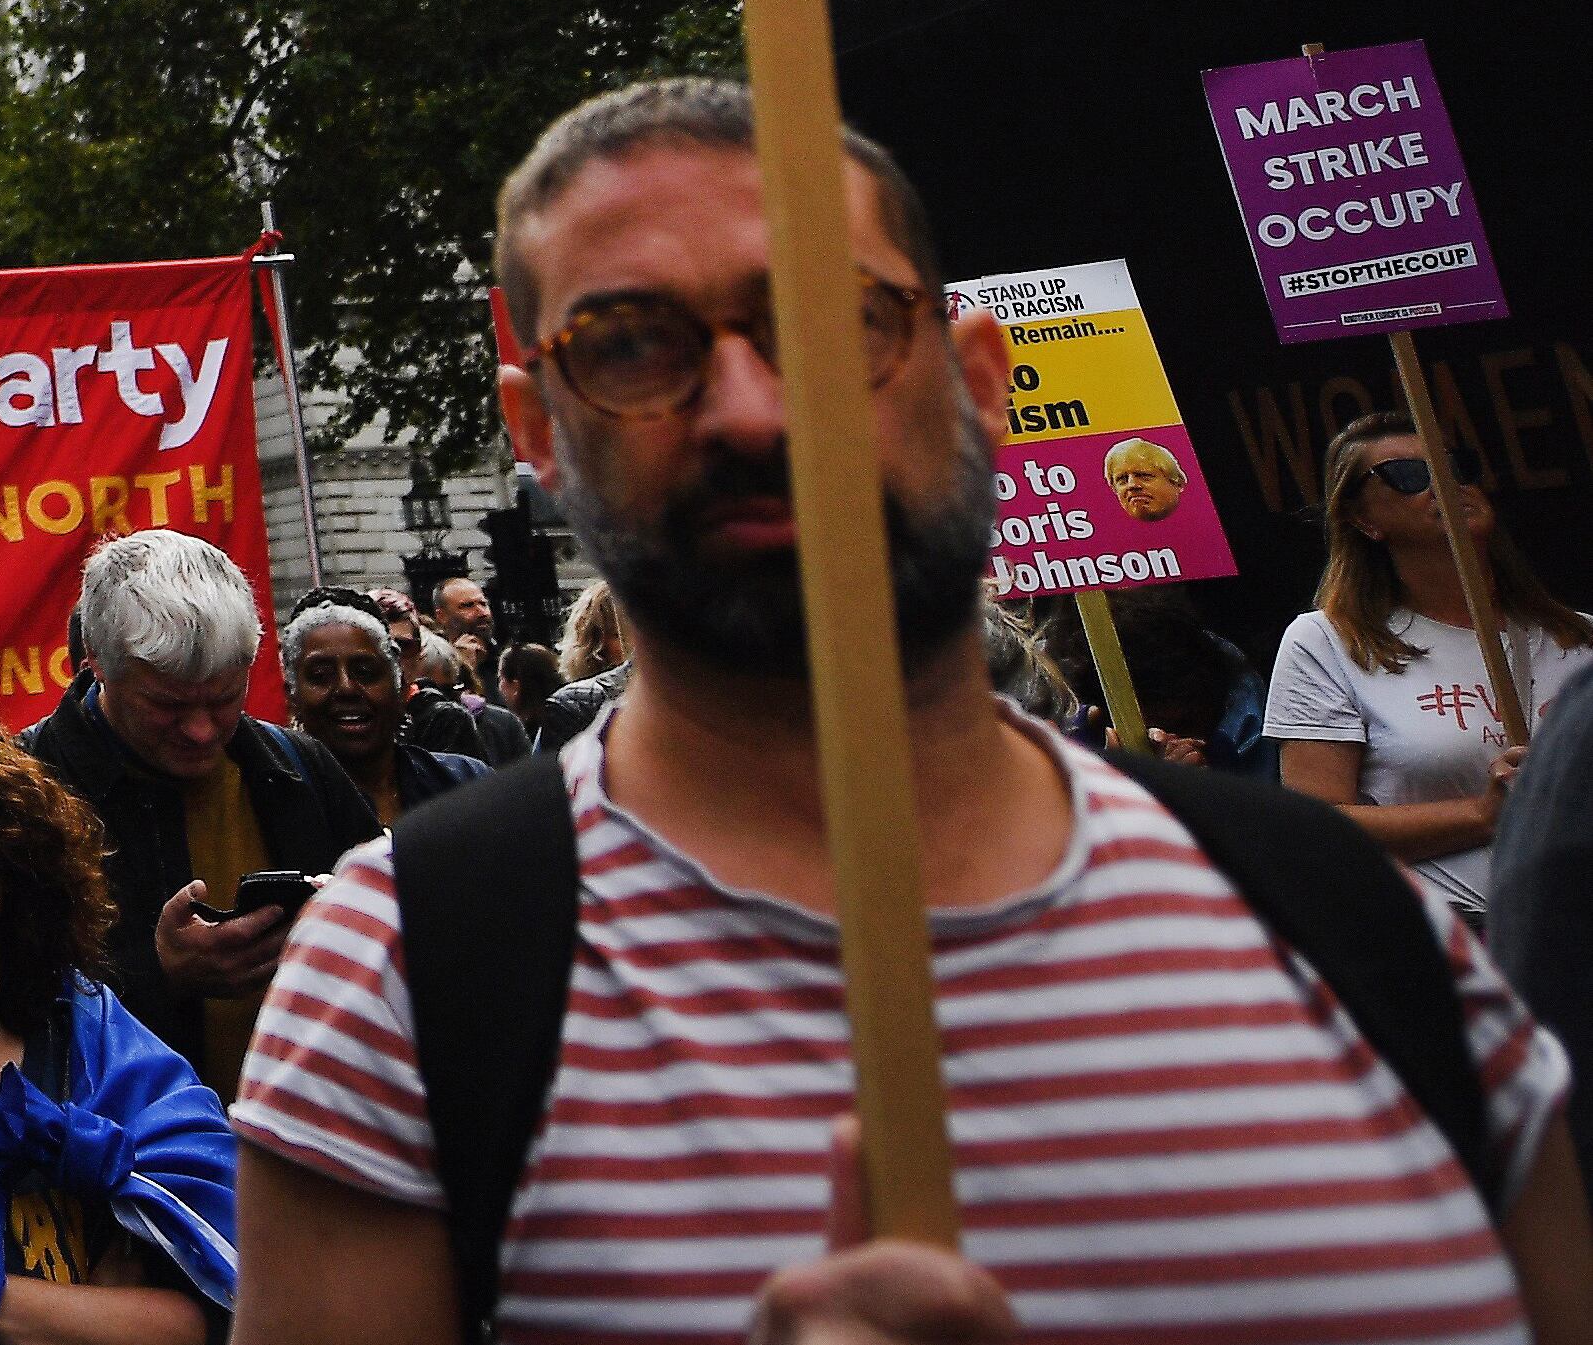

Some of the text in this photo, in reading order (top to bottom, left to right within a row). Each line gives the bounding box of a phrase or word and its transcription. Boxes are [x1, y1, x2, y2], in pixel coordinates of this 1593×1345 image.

[1236, 75, 1422, 140] MARCH
[1263, 131, 1430, 193] STRIKE
[1256, 181, 1465, 250] OCCUPY
[977, 278, 1066, 304] STAND UP
[1287, 246, 1470, 295] #STOPTHECOUP
[1012, 294, 1085, 318] RACISM
[1006, 397, 1091, 435] ism
[1024, 459, 1076, 497] to
[993, 546, 1181, 597] Johnson
